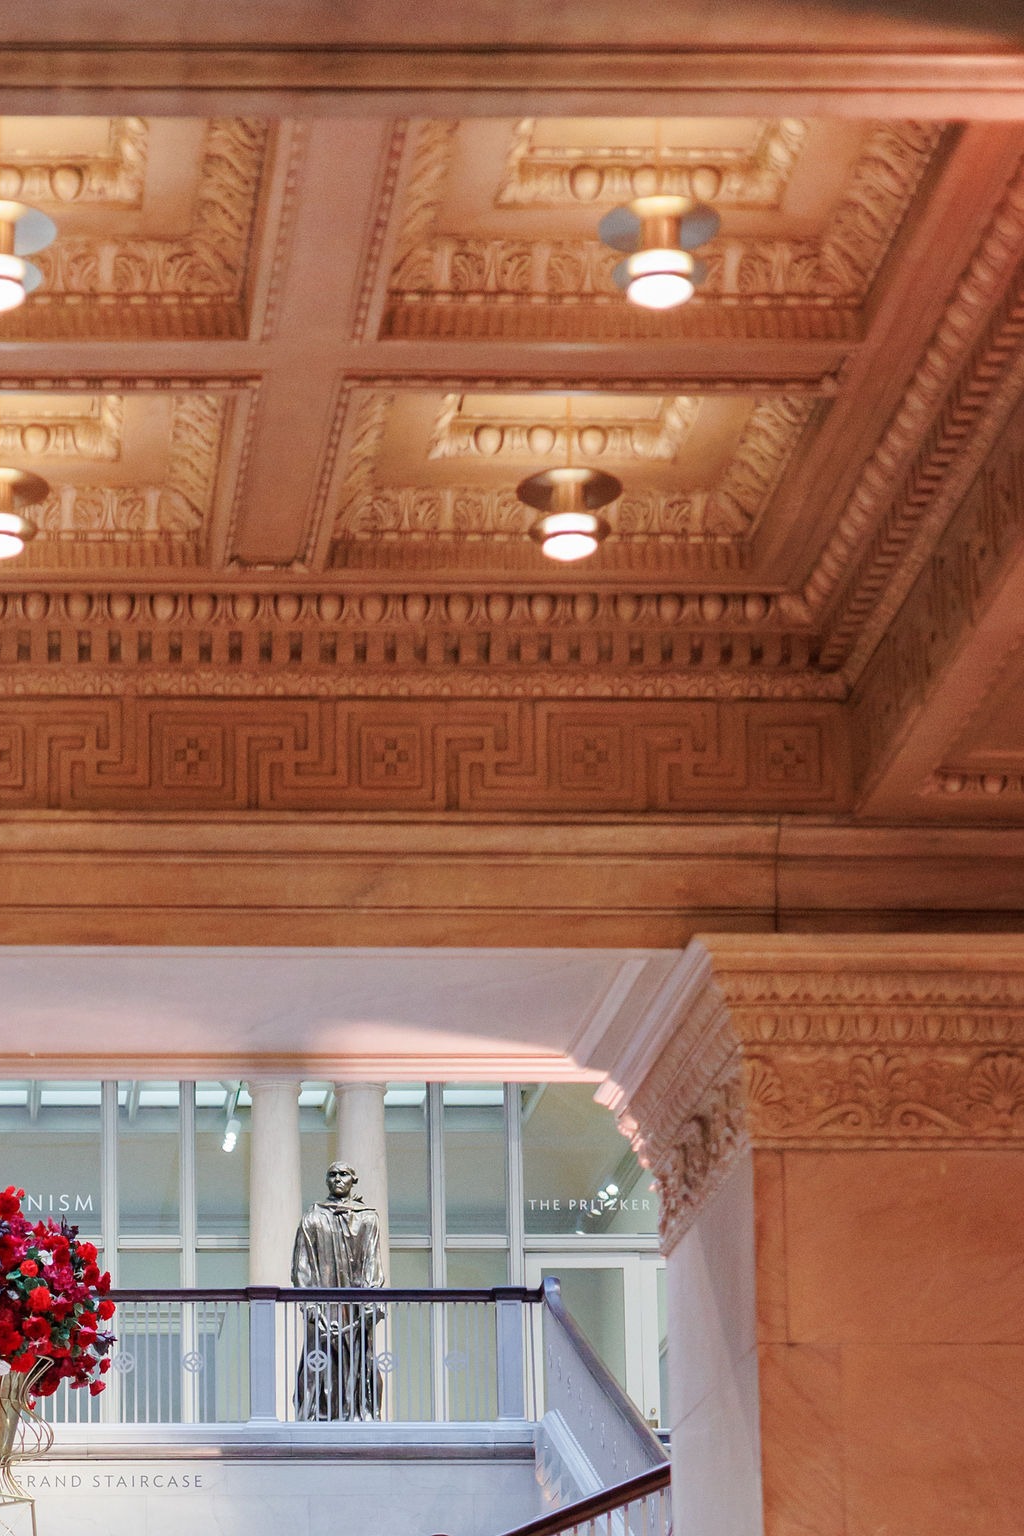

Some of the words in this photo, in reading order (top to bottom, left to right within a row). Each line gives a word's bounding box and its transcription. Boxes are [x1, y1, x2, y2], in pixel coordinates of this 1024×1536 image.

[529, 1199, 561, 1211] THE
[568, 1199, 650, 1211] PRITZKER
[92, 1475, 204, 1488] STAIRCASE
